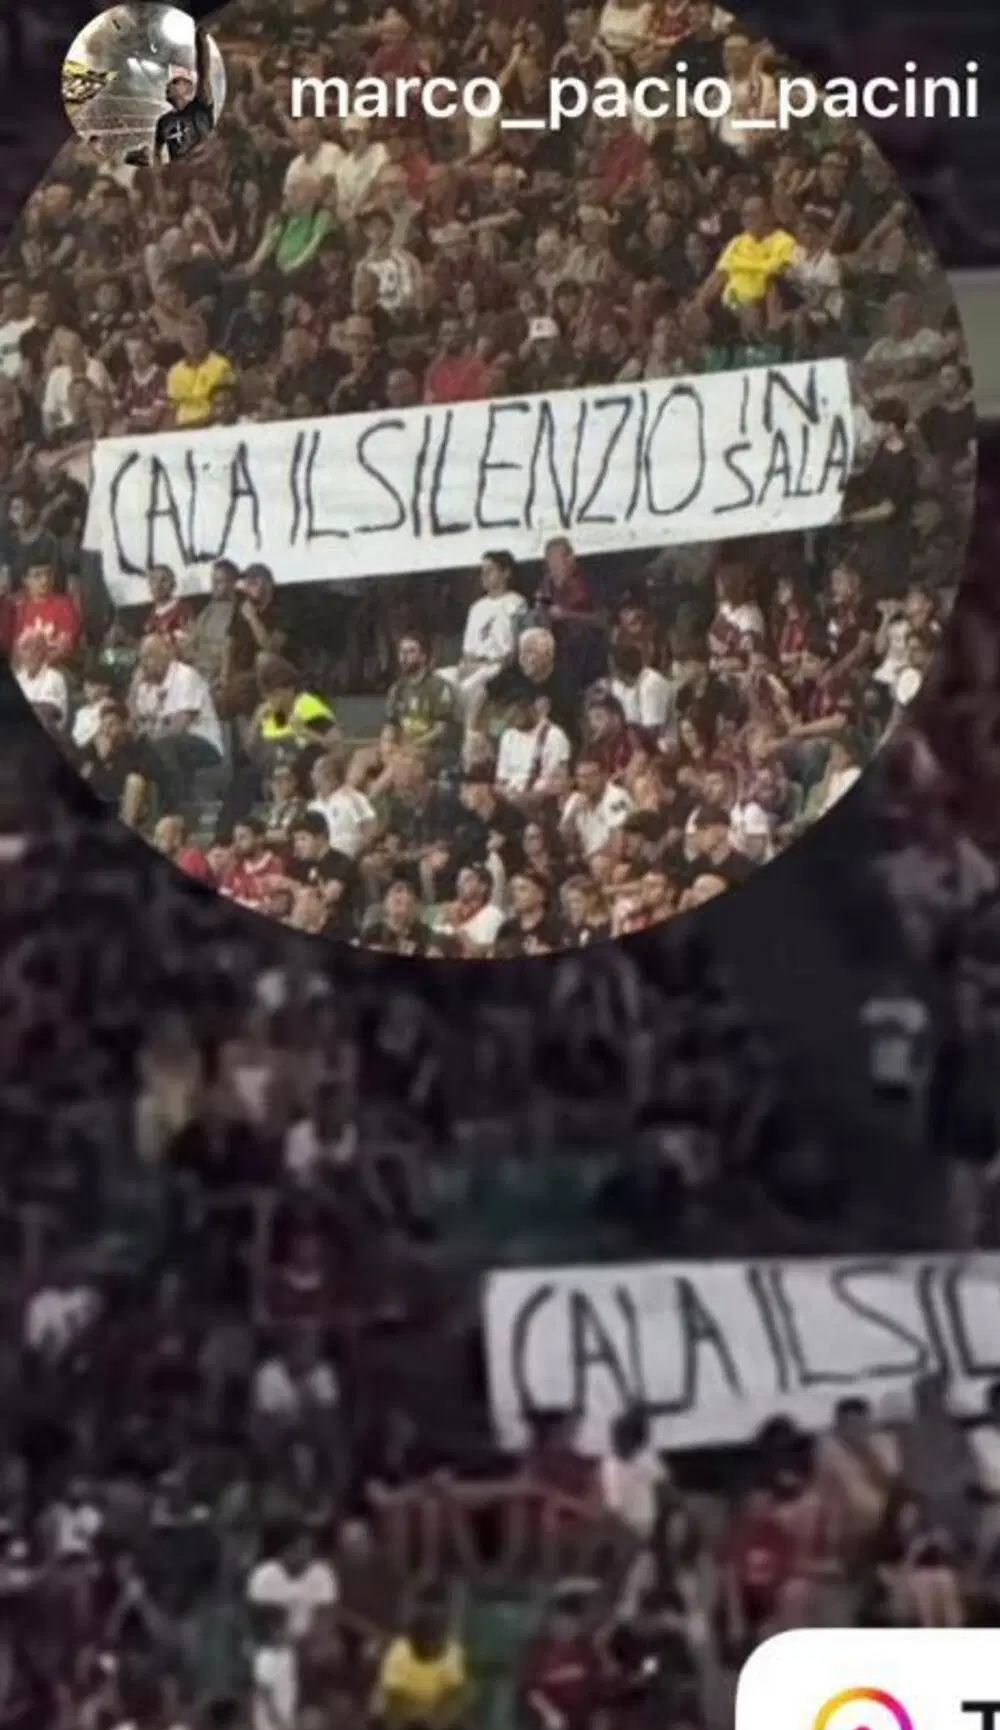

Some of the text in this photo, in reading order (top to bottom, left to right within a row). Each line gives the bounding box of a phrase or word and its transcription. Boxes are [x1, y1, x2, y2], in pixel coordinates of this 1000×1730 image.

[740, 364, 822, 434] IN
[110, 382, 706, 576] CALA IL SILENZIO
[712, 414, 850, 514] SALA
[510, 1276, 743, 1417] CALA
[746, 1263, 858, 1394] IL
